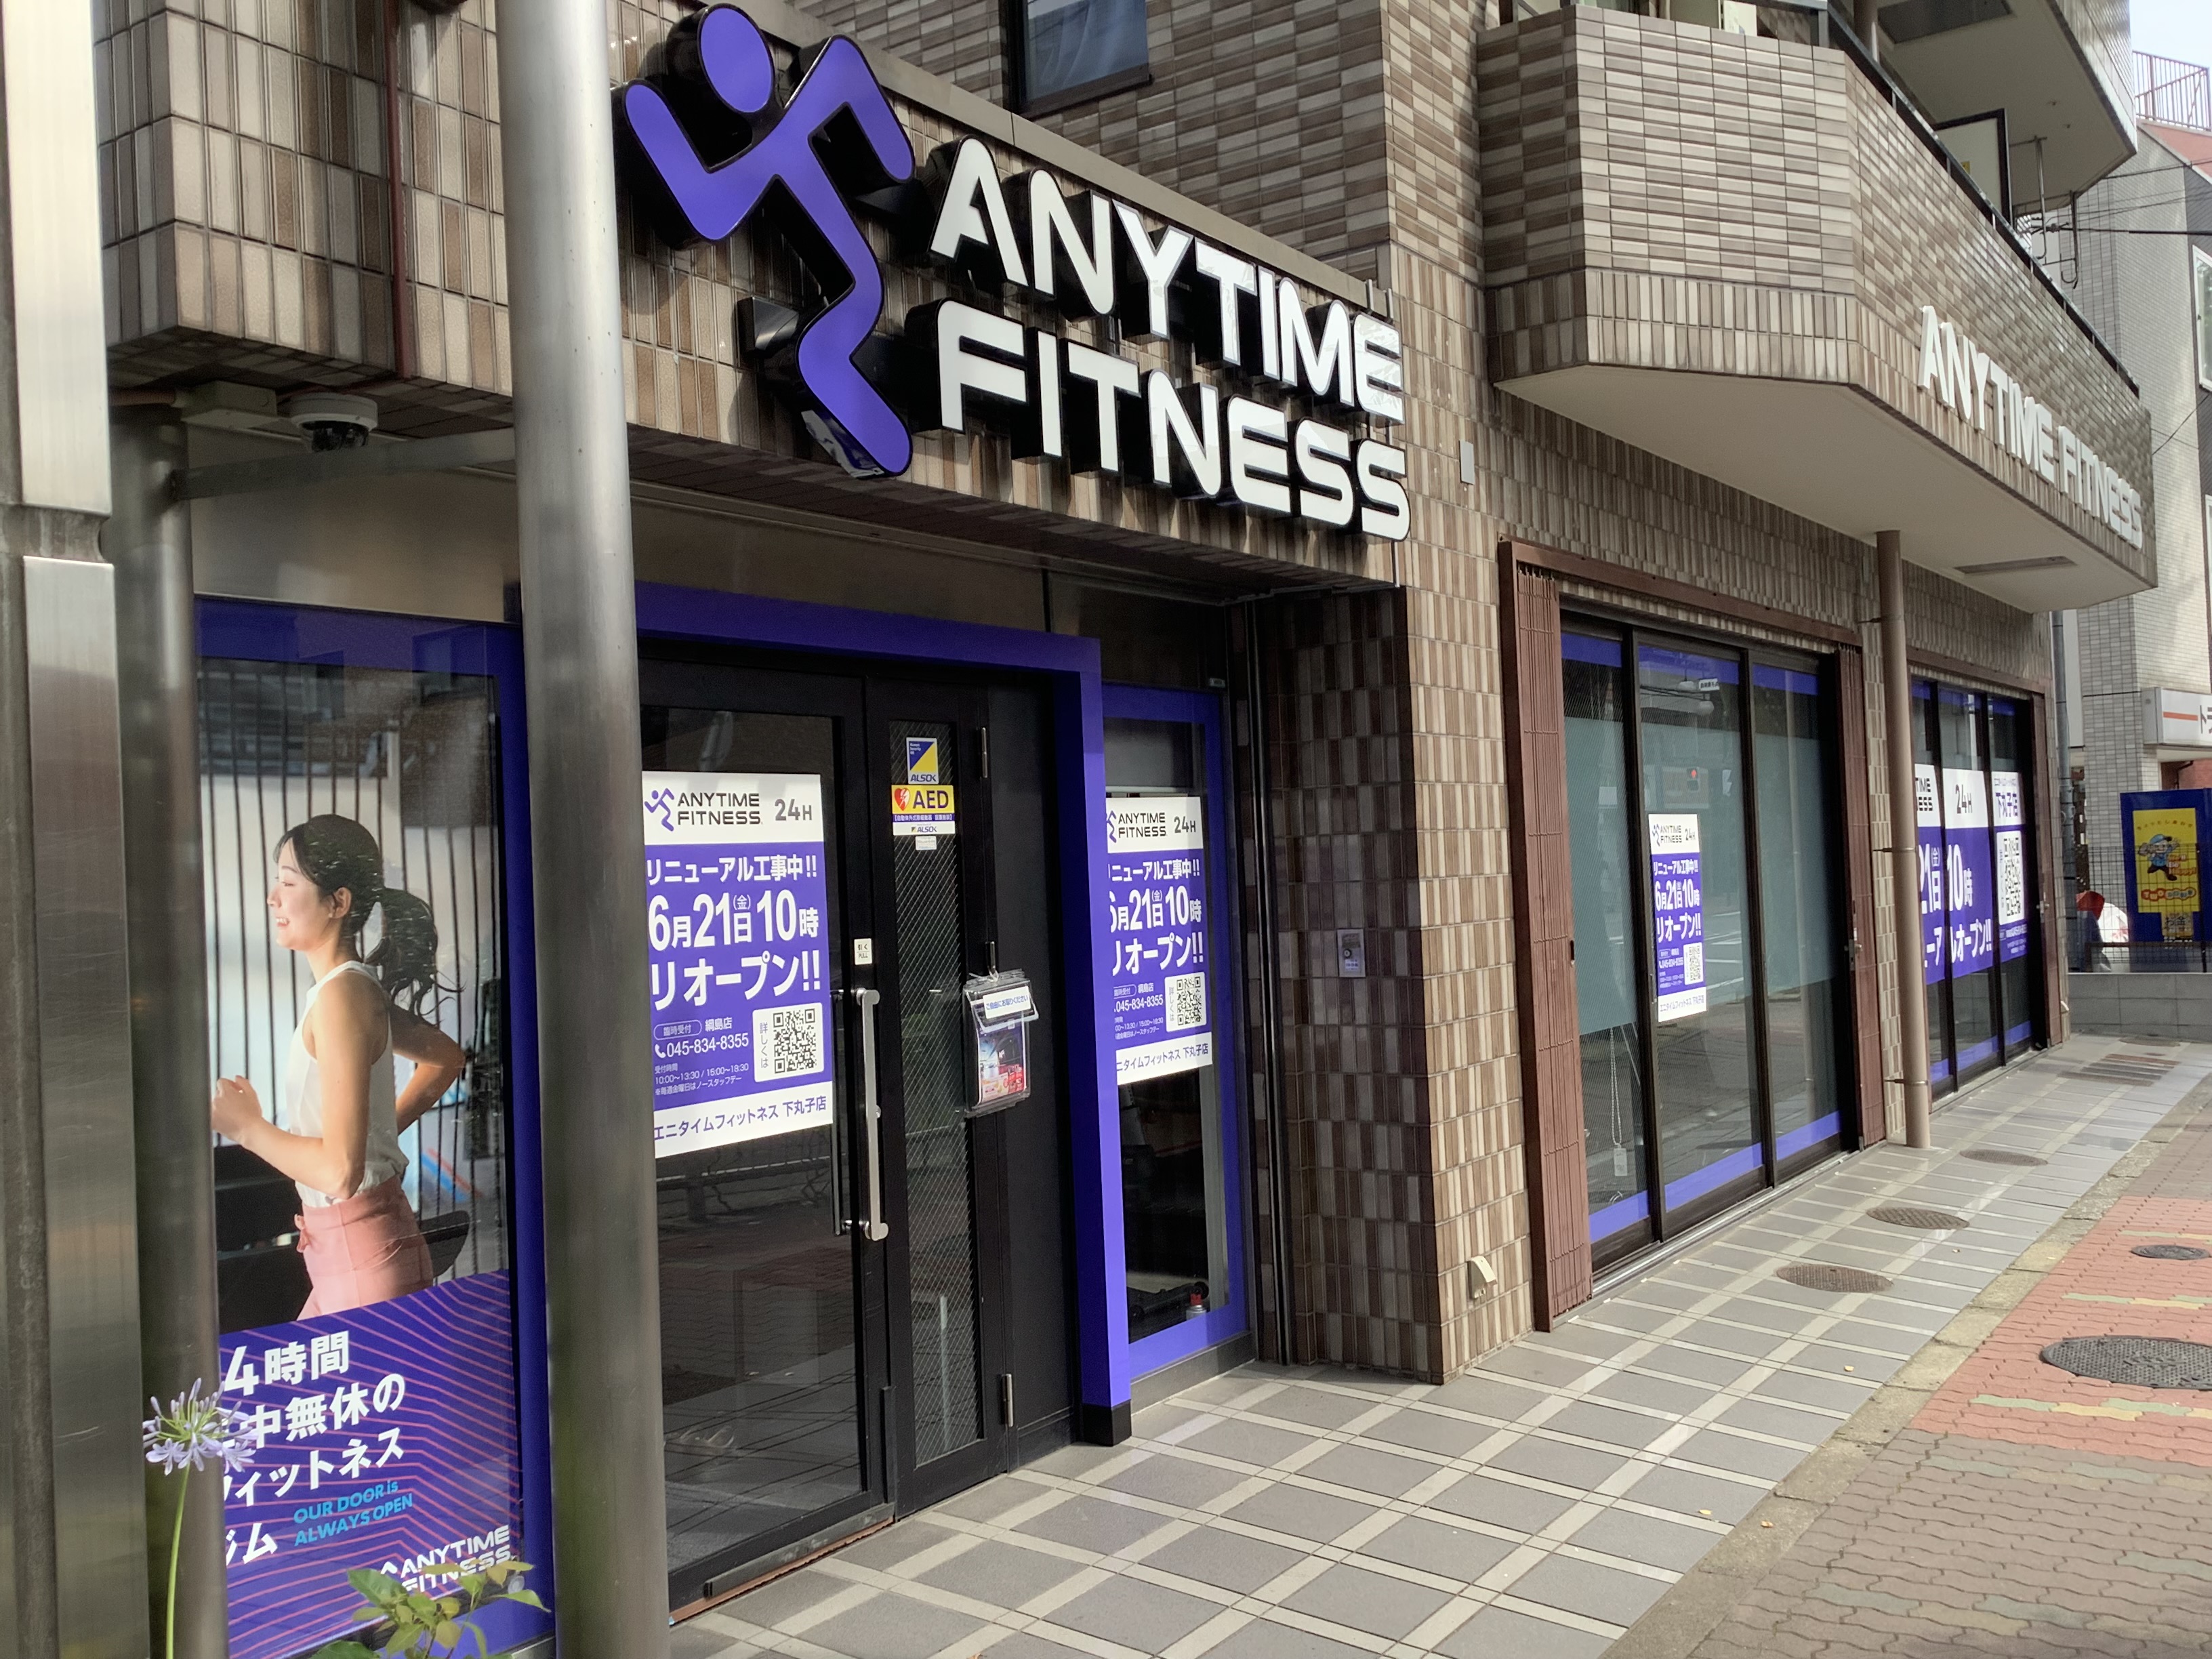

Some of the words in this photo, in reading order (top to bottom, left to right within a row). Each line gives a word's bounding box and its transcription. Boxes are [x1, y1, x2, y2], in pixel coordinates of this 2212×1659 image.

[930, 136, 1405, 425] ANYTIME
[937, 298, 1411, 542] FITNESS
[1918, 306, 2055, 484] ANYTIME
[2058, 425, 2143, 550] FITNESS
[910, 774, 936, 782] ALSOK
[678, 792, 760, 807] ANYTIME
[775, 798, 813, 821] 24H
[913, 790, 949, 809] AED
[1955, 784, 1973, 814] 24H
[678, 811, 760, 825] FITNESS
[1118, 812, 1166, 824] ANYTIME
[1174, 816, 1196, 834] 24H
[1118, 825, 1167, 838] FITNESS
[1660, 825, 1681, 834] ANYTIME
[1660, 834, 1682, 844] FITNESS
[647, 854, 817, 885] リニューアル工事中!!
[1108, 858, 1200, 882] ニューアル工事中!!
[651, 949, 821, 1011] リオープン!!
[1115, 994, 1164, 1012] 045-834-8355
[667, 1032, 749, 1058] 045-834-8355
[759, 1021, 769, 1069] 詳しくは
[1183, 1042, 1209, 1058] 下丸子店
[783, 1095, 826, 1118] 下丸子店
[222, 1374, 406, 1450] 中無休の
[293, 1501, 333, 1523] OUR
[337, 1484, 384, 1513] DOOR
[387, 1479, 398, 1494] is
[294, 1511, 370, 1546] ALWAYS
[373, 1493, 413, 1520] OPEN
[400, 1525, 510, 1578] ANYTIME
